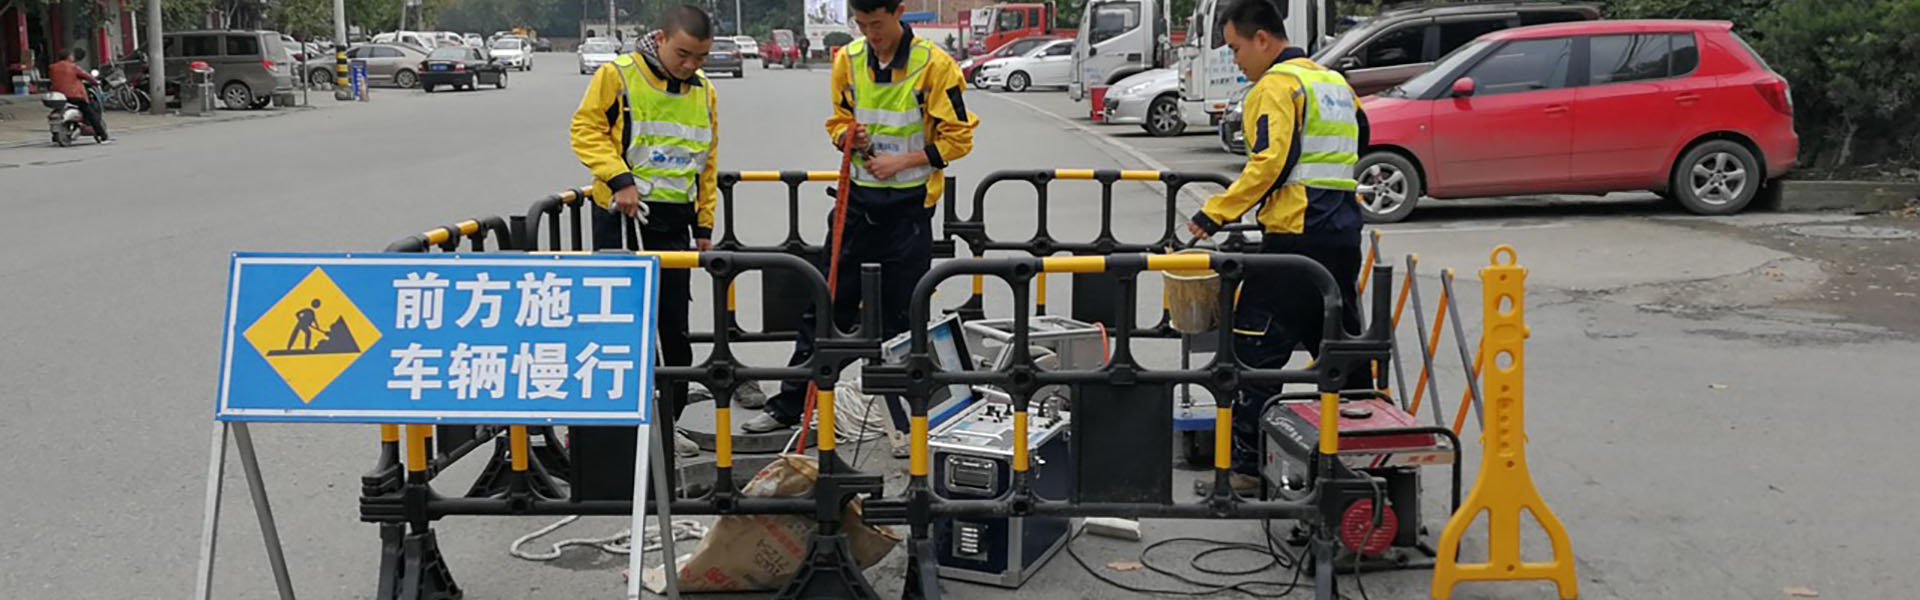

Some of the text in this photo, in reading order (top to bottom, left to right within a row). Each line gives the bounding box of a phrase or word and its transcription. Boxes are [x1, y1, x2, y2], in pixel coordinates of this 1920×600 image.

[393, 272, 634, 330] 前方施工
[387, 342, 634, 400] 车辆慢行
